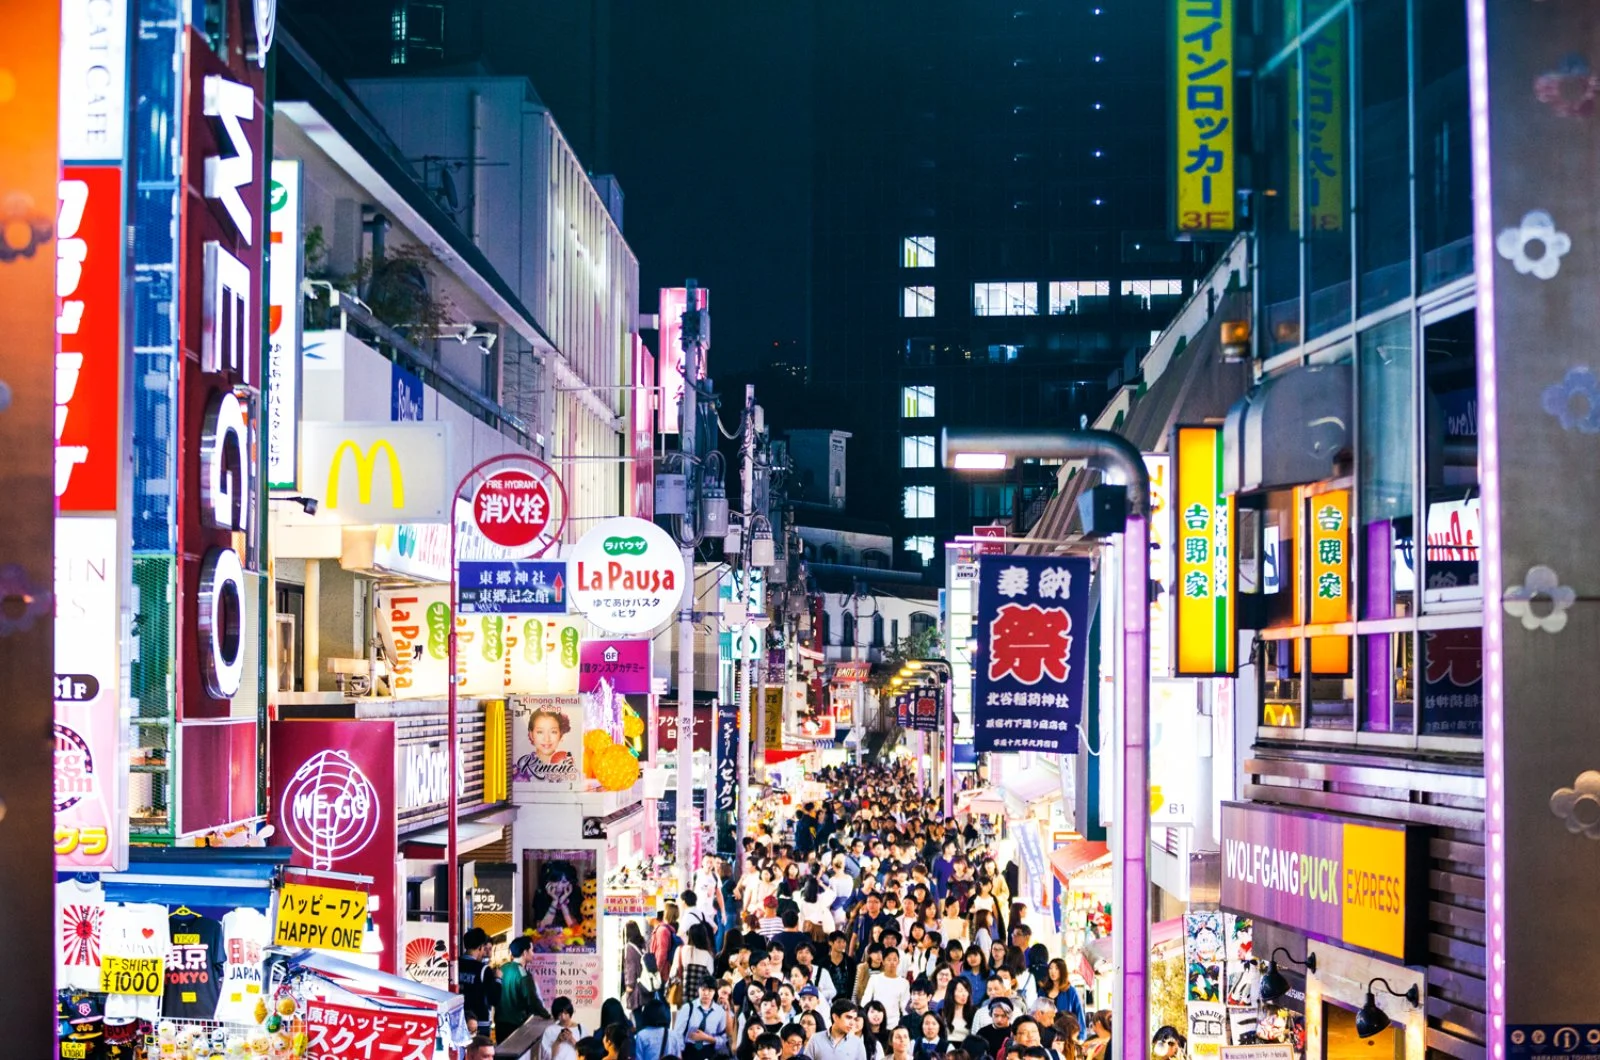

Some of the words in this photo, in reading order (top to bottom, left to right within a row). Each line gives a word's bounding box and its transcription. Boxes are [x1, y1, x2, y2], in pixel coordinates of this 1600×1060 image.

[1183, 0, 1229, 205] コインロッカー
[1182, 211, 1229, 230] 3F
[200, 74, 254, 698] WEGO
[486, 480, 502, 489] FIRE
[505, 480, 538, 489] HYDRANT
[480, 493, 545, 525] 消火栓
[1184, 503, 1210, 599] 吉野家
[479, 570, 547, 586] 東郷神社
[577, 561, 603, 591] La
[608, 561, 674, 593] Pausa
[479, 588, 549, 604] 東郷記念館
[605, 652, 616, 660] 6F
[988, 603, 1074, 686] 祭
[523, 697, 553, 705] Kimono
[555, 696, 580, 704] Rental
[541, 704, 562, 713] Shop
[986, 692, 1070, 709] 北谷稲荷神社
[517, 754, 575, 781] Kimono
[1169, 803, 1185, 815] B1
[1225, 838, 1299, 896] WOLFGANG
[1299, 855, 1339, 906] PUCK
[1347, 869, 1400, 915] EXPRESS
[282, 893, 365, 921] ハッピーワン
[278, 921, 327, 945] HAPPY
[331, 927, 362, 949] ONE
[106, 958, 159, 973] T-SHIRT
[229, 966, 261, 980] JAPAN
[102, 971, 160, 994] ¥1000
[308, 1007, 436, 1038] 原宿ハッピーワン
[307, 1025, 433, 1060] スクイーズ
